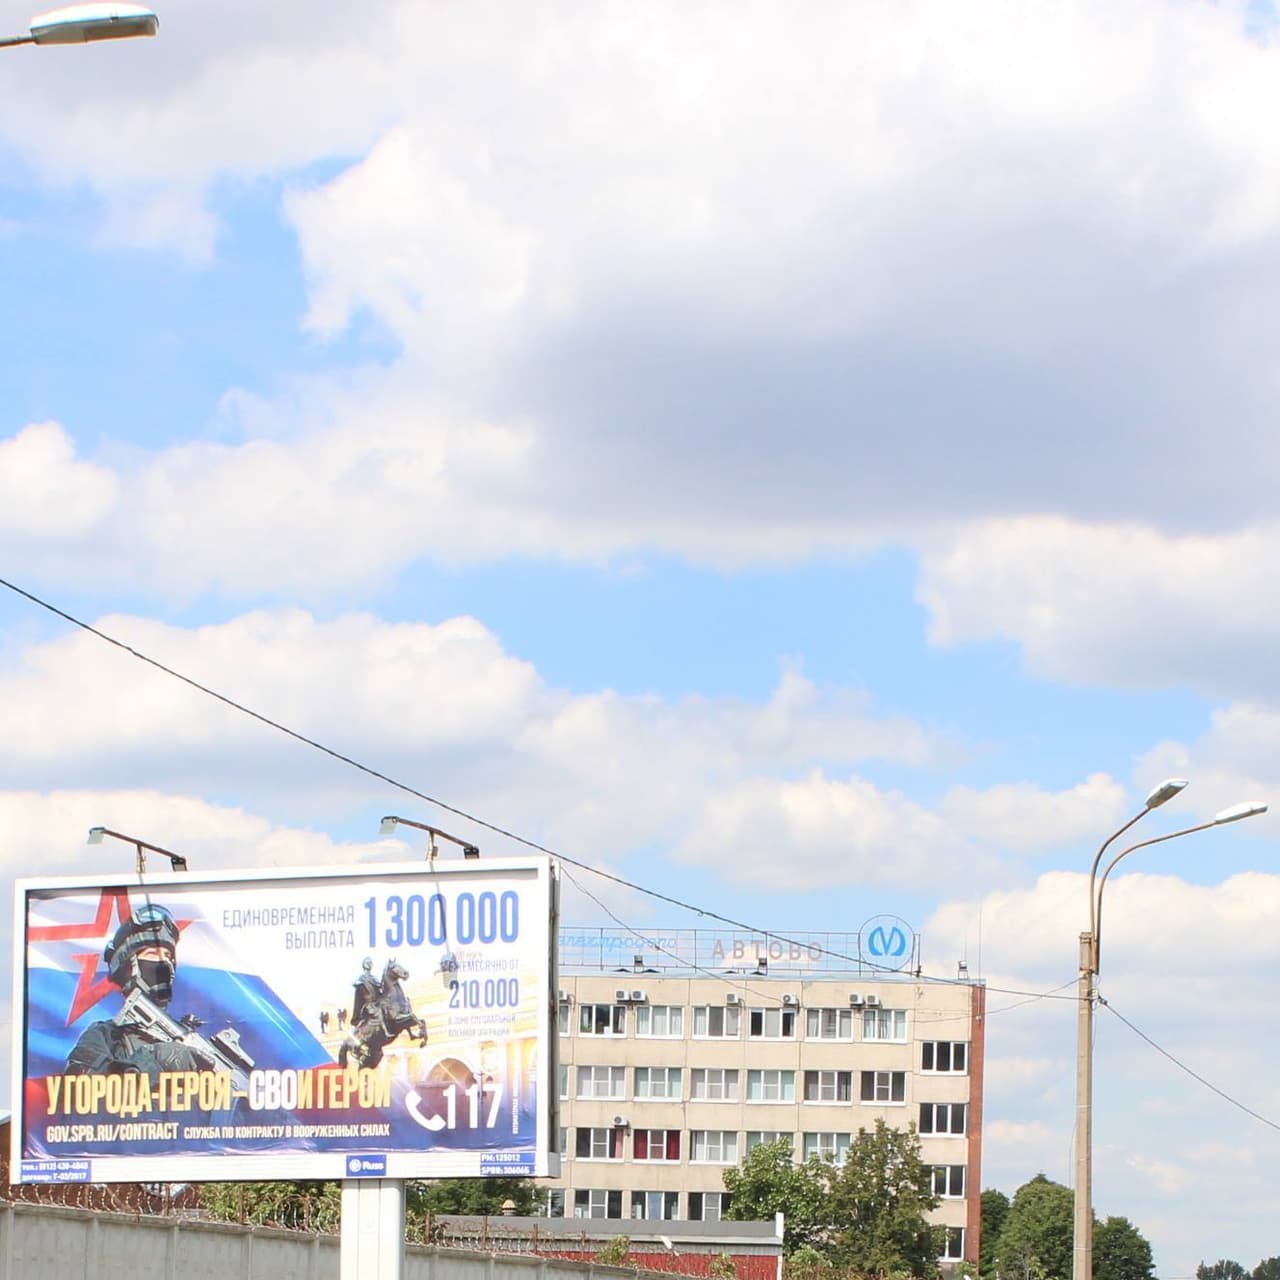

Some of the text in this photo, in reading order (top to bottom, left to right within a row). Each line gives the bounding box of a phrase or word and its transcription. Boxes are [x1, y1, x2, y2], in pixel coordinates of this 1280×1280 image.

[223, 904, 355, 929] ЕДИНОВРЕМЕННАЯ
[364, 890, 519, 949] 1 300 000
[285, 930, 355, 950] ВЫПЛАТА
[712, 939, 822, 961] АВТОВО
[46, 1075, 61, 1115] У
[63, 1069, 232, 1118] ГОРОДА-ГЕРОЯ
[249, 1068, 313, 1111] СВОИ
[317, 1066, 392, 1109] ГЕРОИ
[442, 1083, 504, 1130] 117
[46, 1122, 180, 1143] GOV.SPB.RU/CONTRACT
[183, 1124, 390, 1139] СЛУЖБА ПО КОНТРАКТУ В ВООРУЖЕННЫХ СИЛАХ
